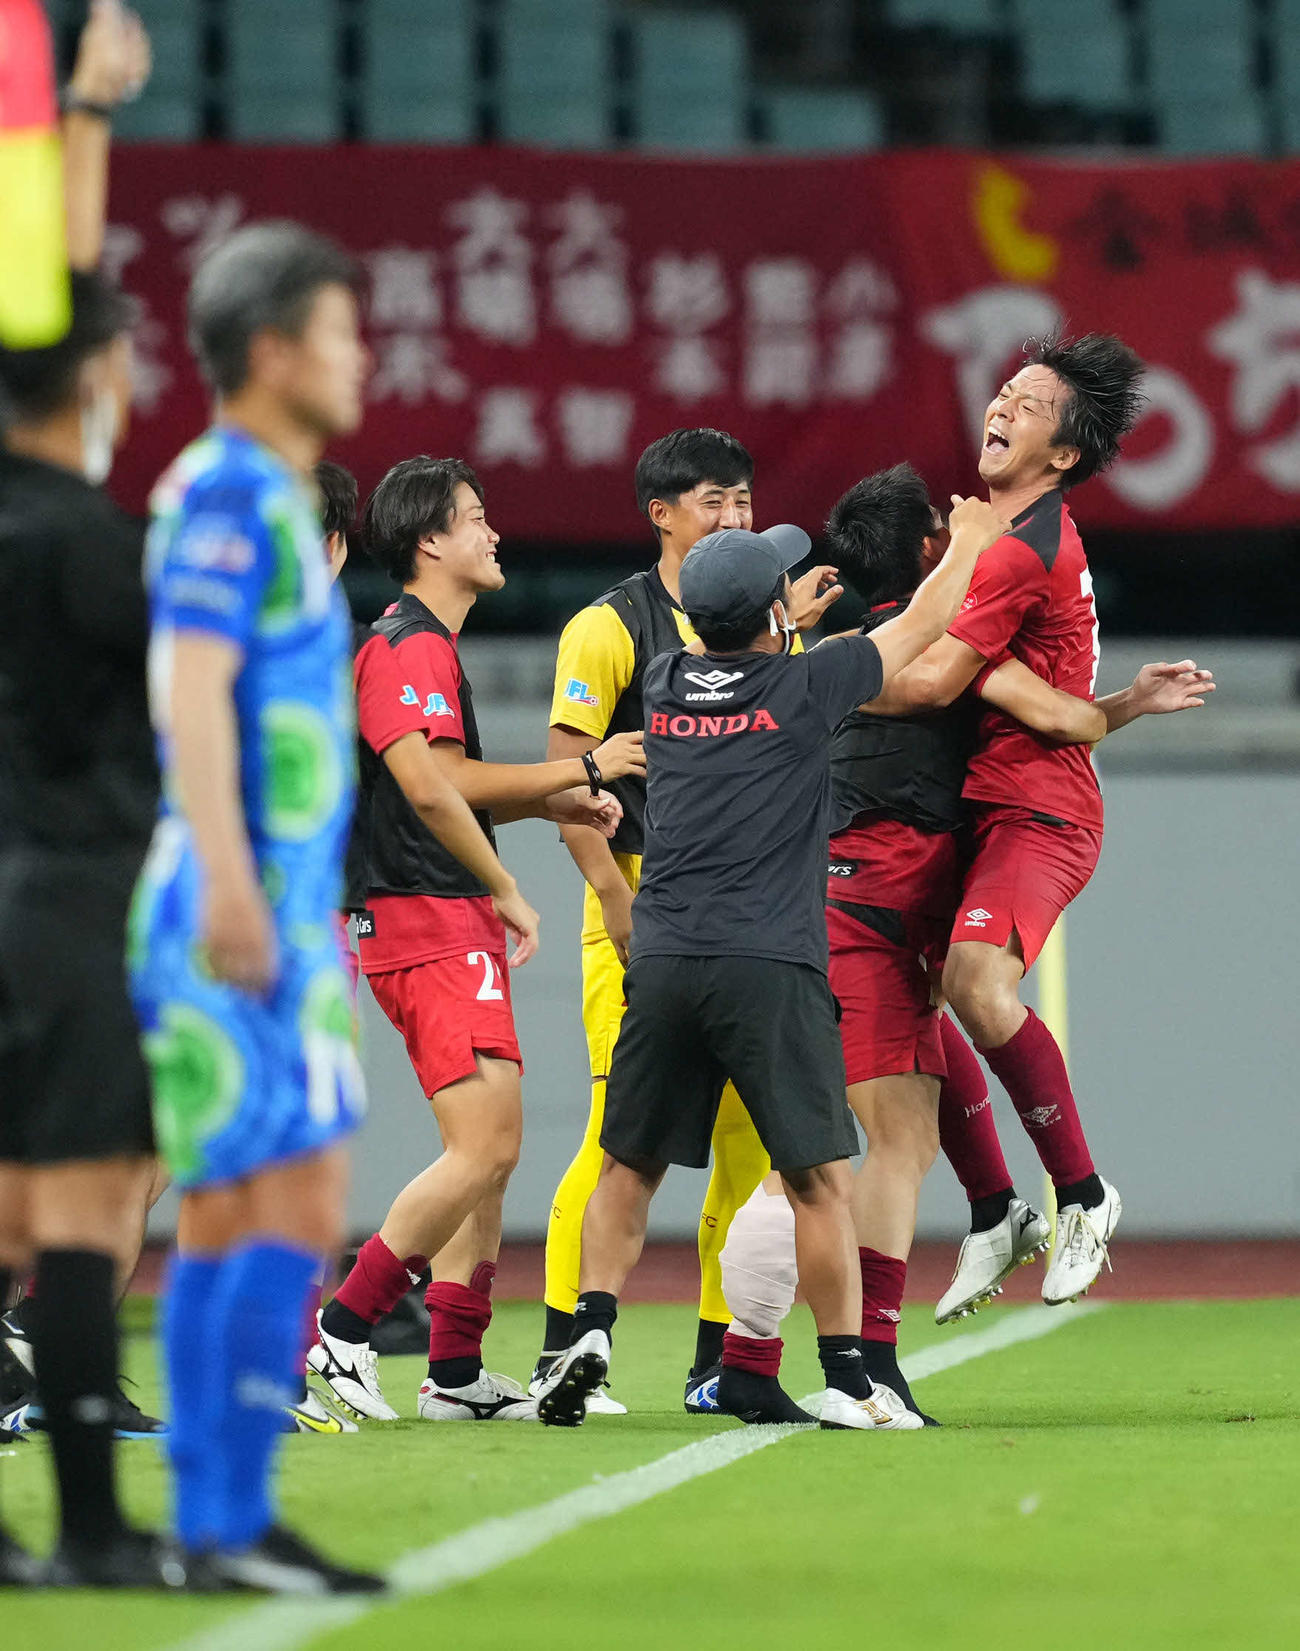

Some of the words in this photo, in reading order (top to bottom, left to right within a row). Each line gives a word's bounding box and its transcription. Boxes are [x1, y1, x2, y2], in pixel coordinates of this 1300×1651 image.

[685, 690, 735, 701] umbro
[650, 709, 780, 737] HONDA
[467, 951, 504, 1001] 2
